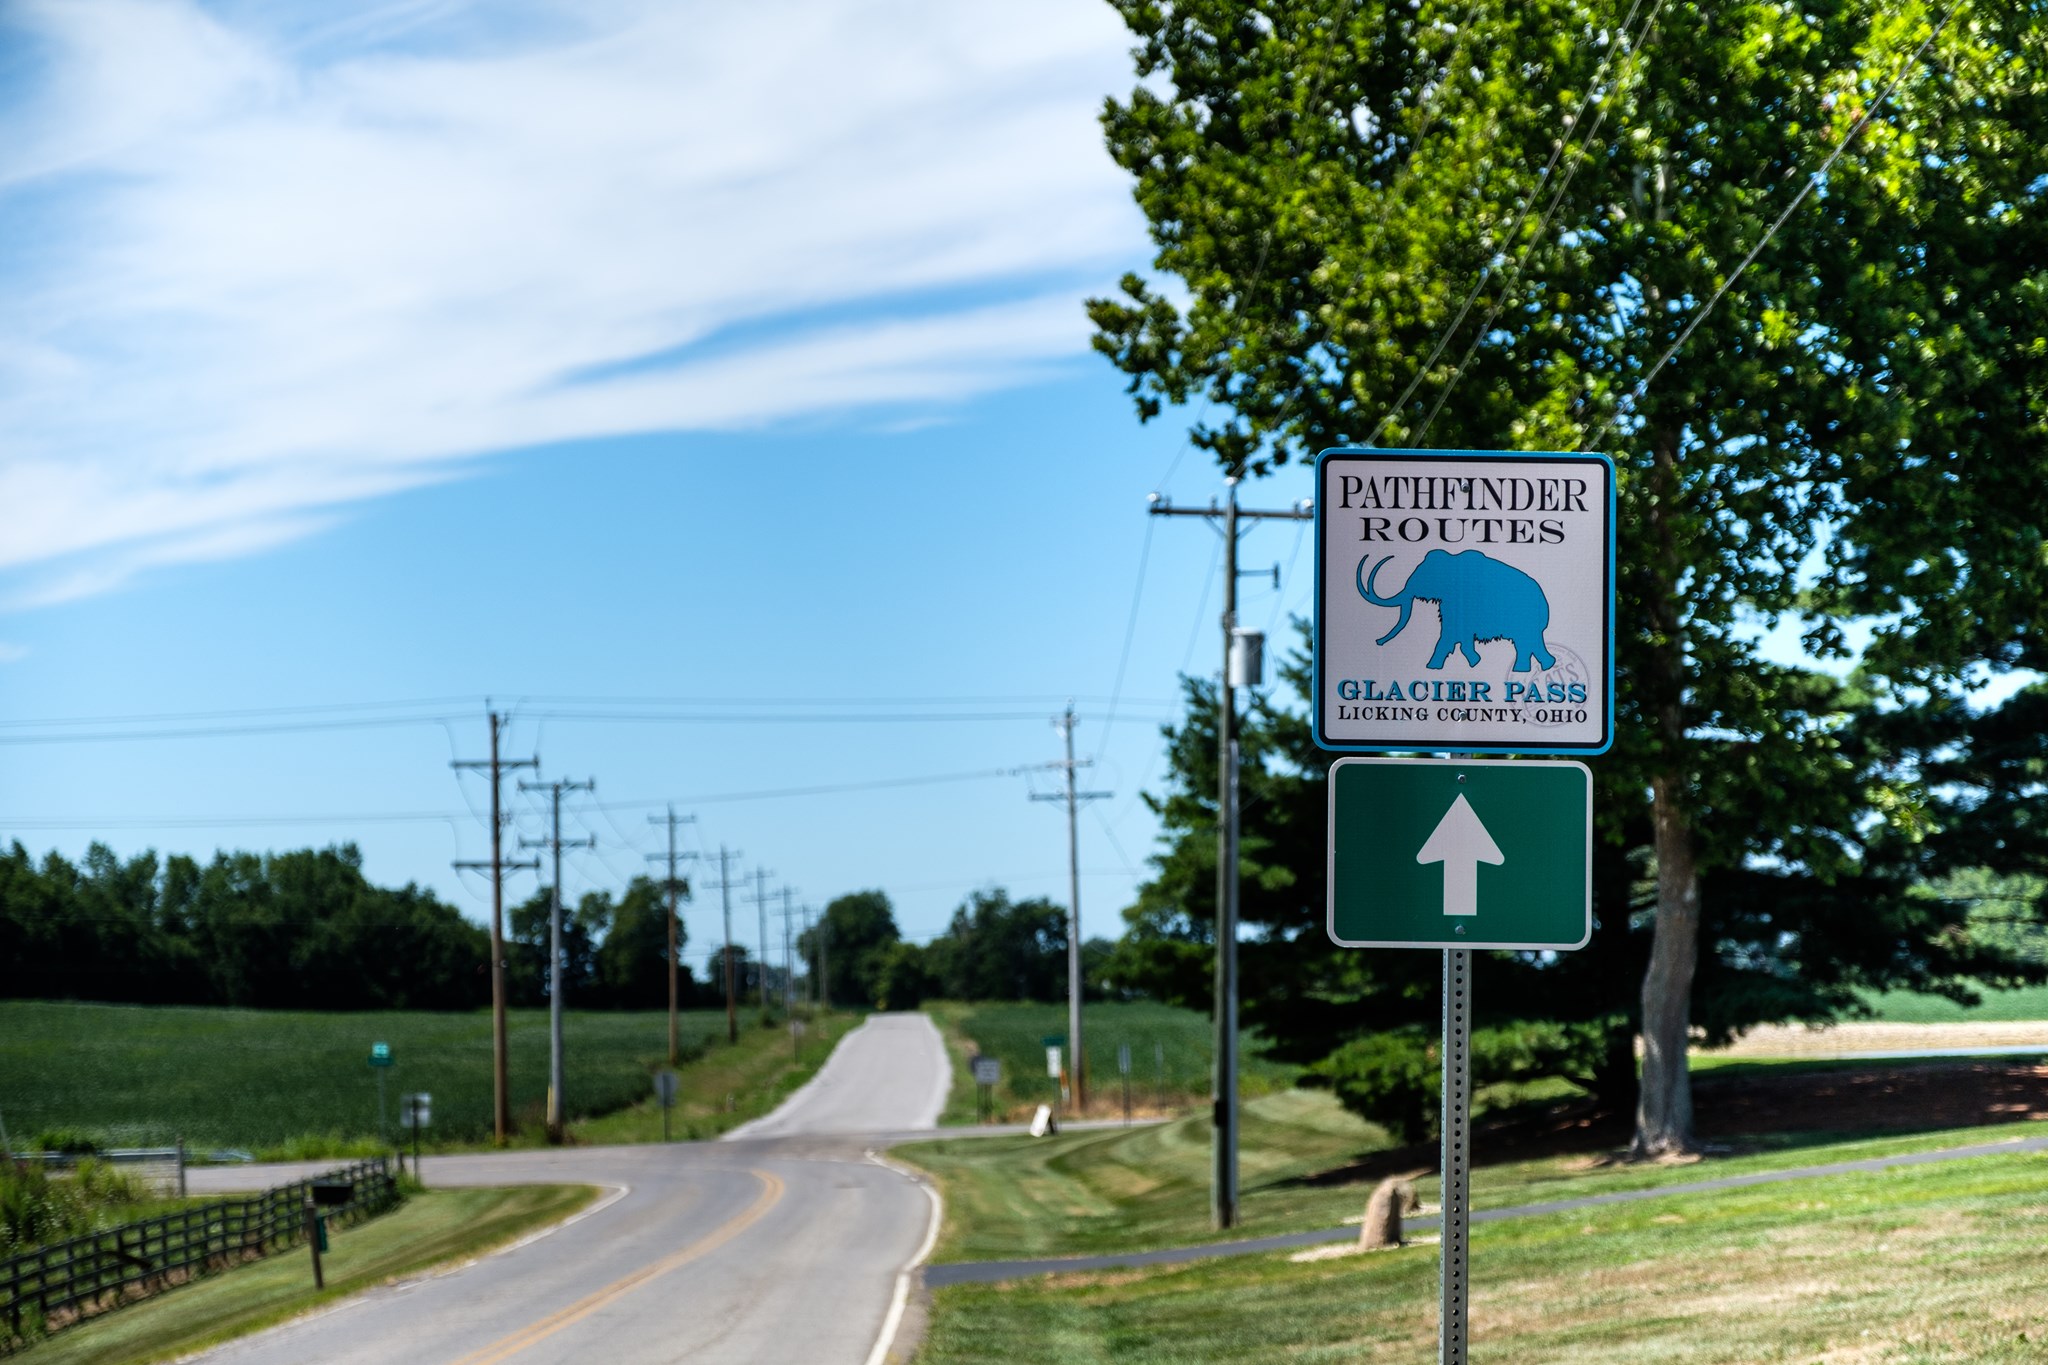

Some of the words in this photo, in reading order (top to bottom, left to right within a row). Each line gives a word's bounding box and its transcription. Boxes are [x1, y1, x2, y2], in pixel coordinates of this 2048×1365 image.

[1338, 475, 1589, 512] PATHFINDER
[1359, 517, 1566, 544] ROUTES
[1337, 679, 1493, 702] GLACIER
[1503, 681, 1588, 704] PASS
[1338, 705, 1429, 721] LICKING
[1437, 707, 1527, 724] COUNTY,
[1535, 708, 1588, 723] OHIO
